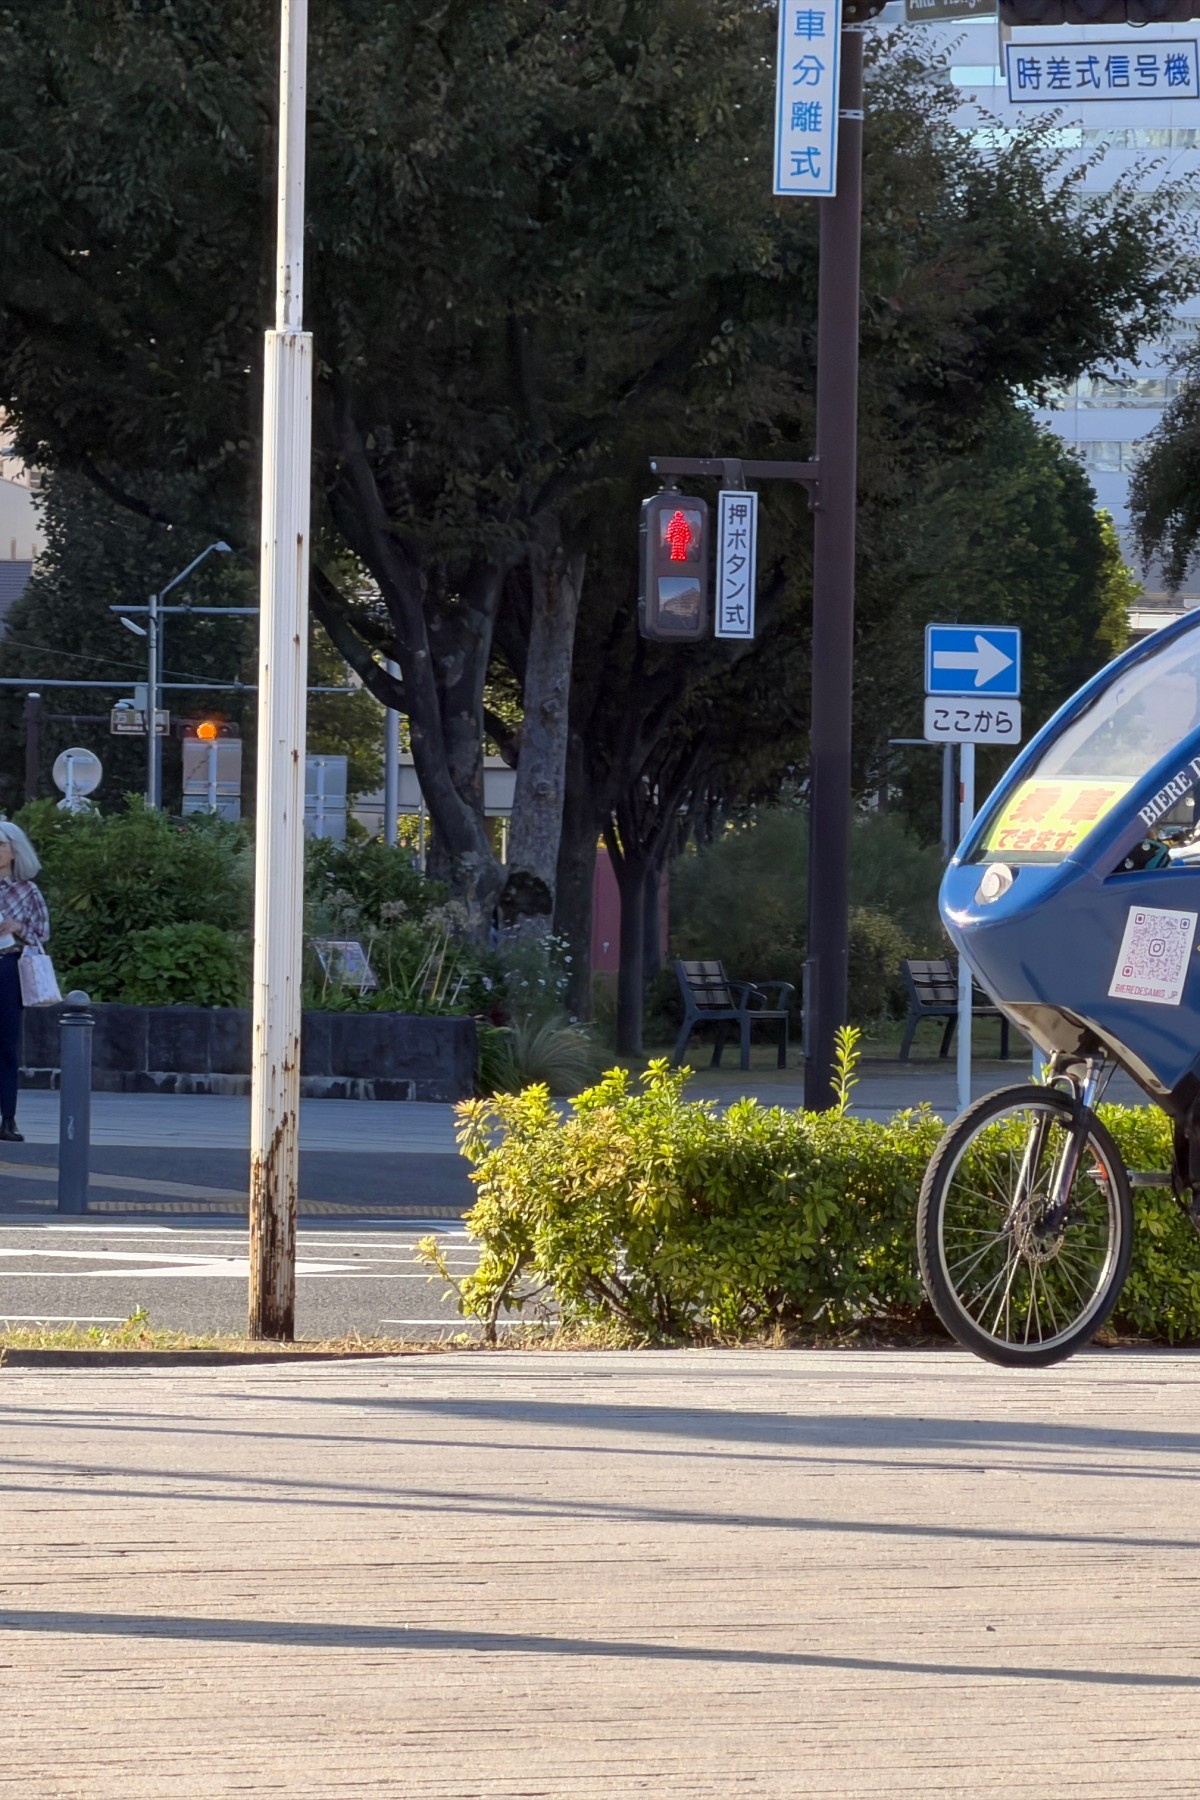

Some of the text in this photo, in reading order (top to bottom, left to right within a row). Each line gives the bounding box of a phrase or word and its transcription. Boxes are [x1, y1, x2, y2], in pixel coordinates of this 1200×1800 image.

[790, 8, 826, 179] 車分離式
[1016, 53, 1191, 90] 時差式信号機
[726, 503, 748, 625] 押ボタン式
[933, 710, 1013, 734] ここから
[1137, 771, 1193, 828] BIERE
